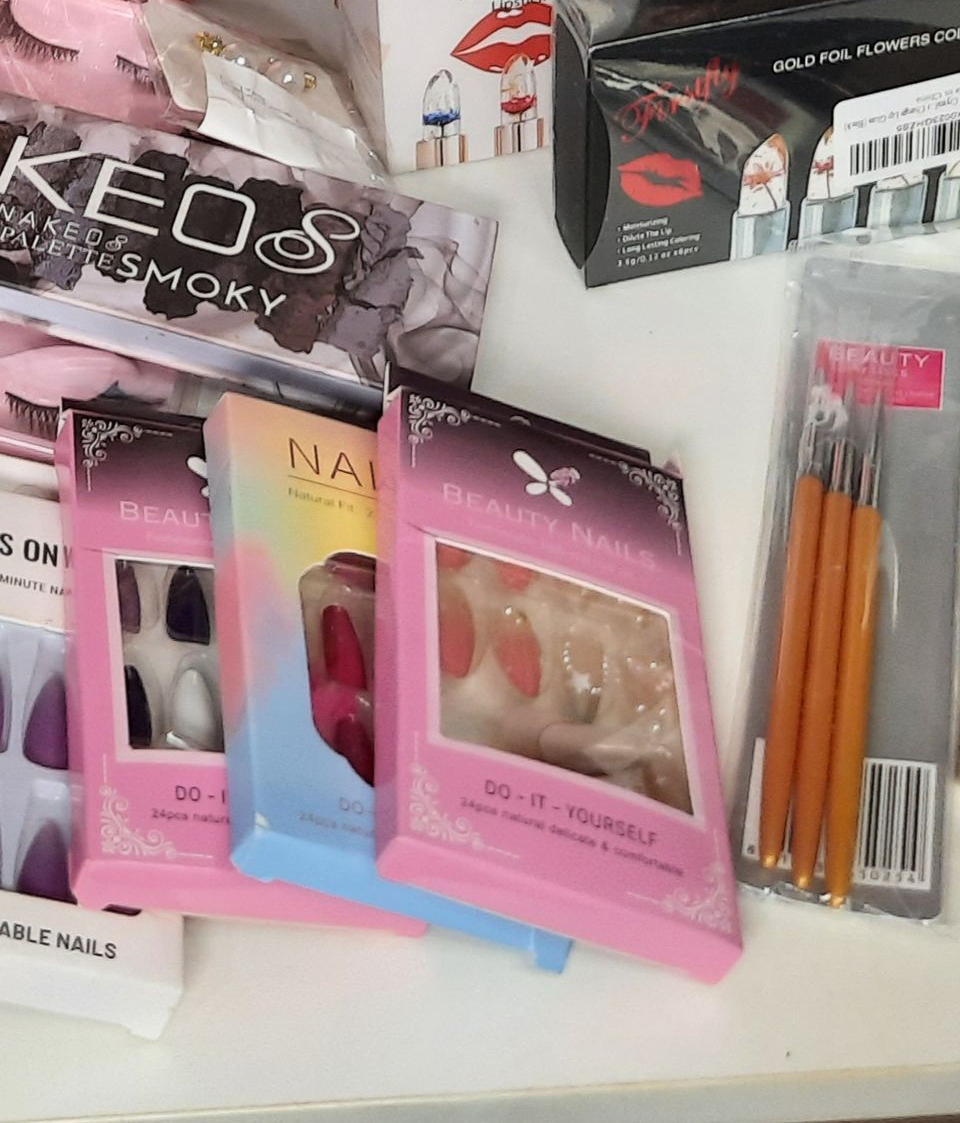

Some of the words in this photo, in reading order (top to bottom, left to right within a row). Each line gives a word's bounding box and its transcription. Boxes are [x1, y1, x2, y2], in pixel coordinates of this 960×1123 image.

[773, 54, 816, 73] GOLD
[819, 48, 852, 65] FOIL
[856, 32, 931, 58] FLOWERS
[117, 253, 287, 316] SMOKY
[828, 346, 931, 368] BEAUTY
[442, 483, 559, 534] BEAUTY
[572, 521, 657, 569] NAILS
[23, 538, 58, 568] ON
[0, 573, 46, 593] MINUTE
[175, 784, 201, 803] DO
[339, 796, 364, 815] DO
[484, 779, 511, 800] DO
[530, 792, 547, 810] IT
[564, 804, 660, 848] YOURSELF
[56, 931, 118, 960] NAILS
